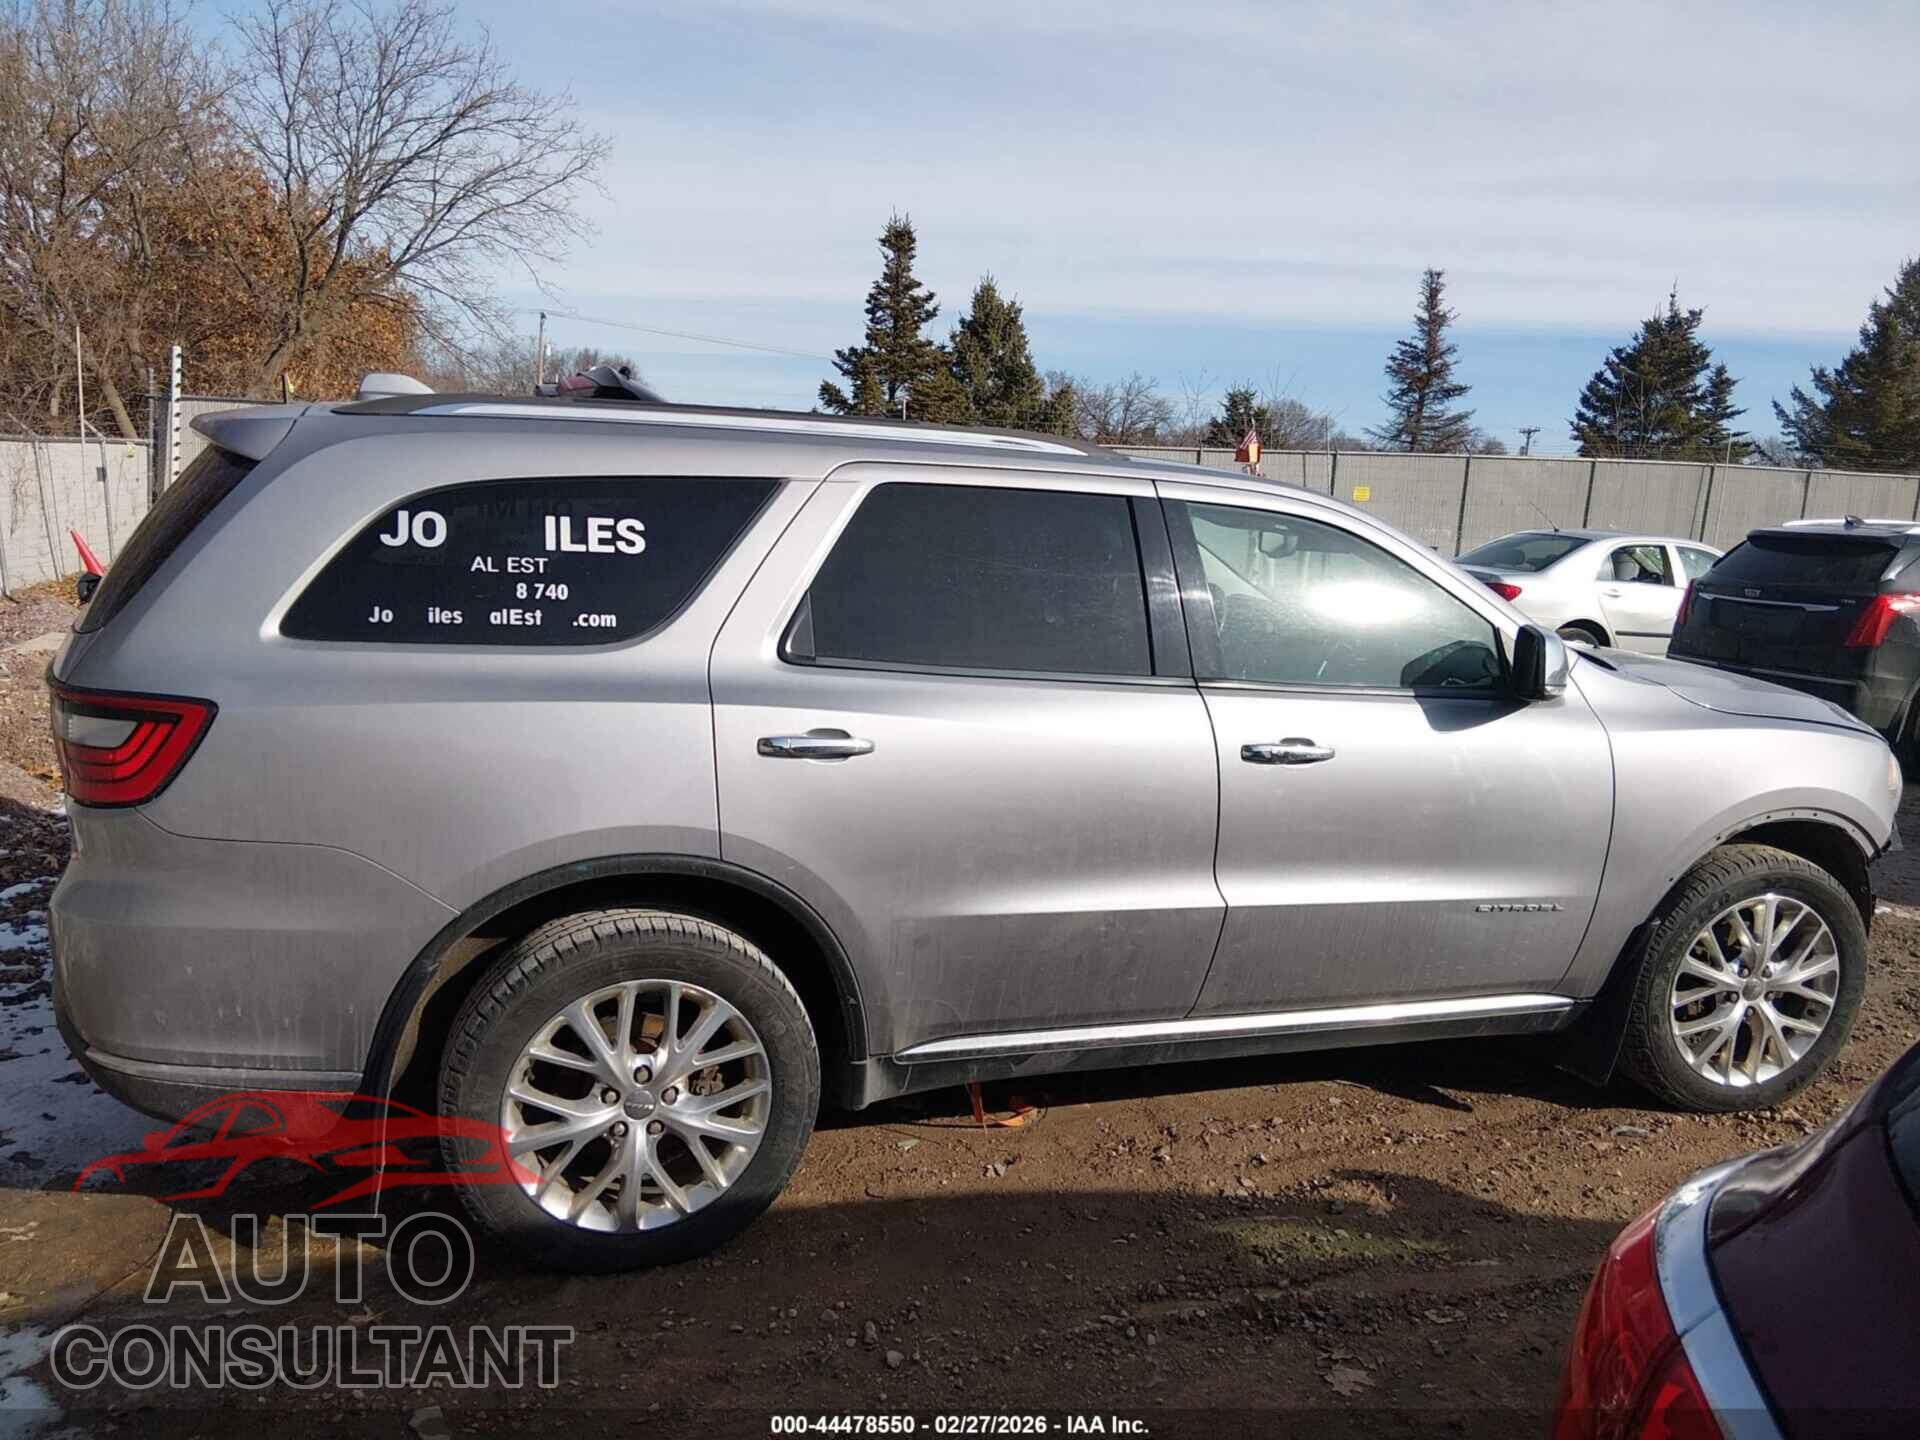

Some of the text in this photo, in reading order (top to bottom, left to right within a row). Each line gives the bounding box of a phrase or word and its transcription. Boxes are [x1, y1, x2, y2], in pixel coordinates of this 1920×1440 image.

[380, 510, 646, 554] JO ILES
[471, 556, 549, 574] AL EST
[516, 582, 569, 601] 8 740
[368, 606, 617, 628] Jo iles alEst .com
